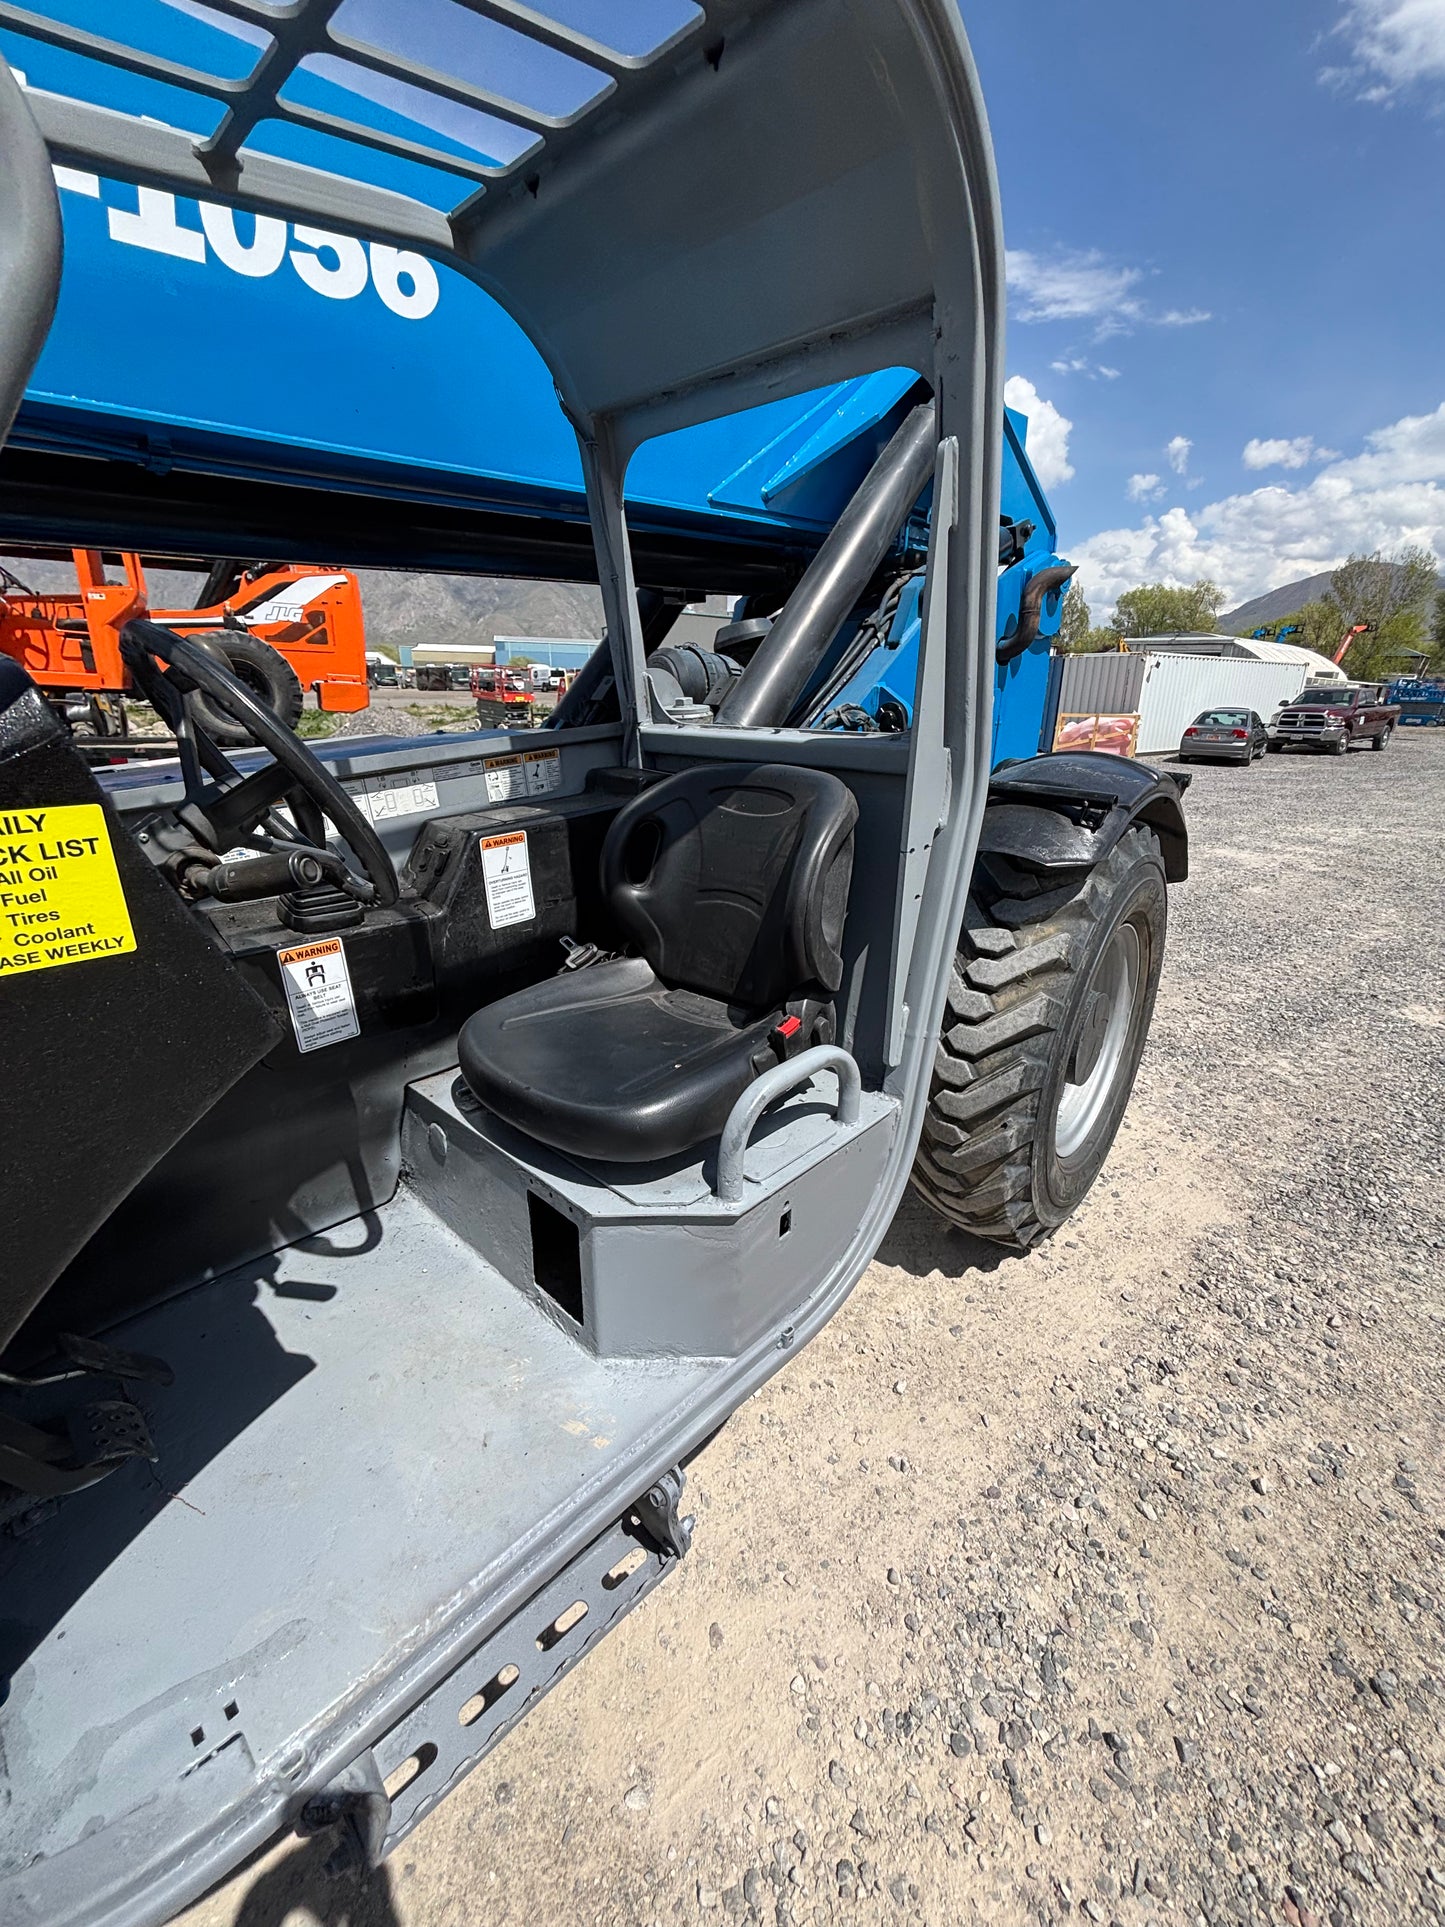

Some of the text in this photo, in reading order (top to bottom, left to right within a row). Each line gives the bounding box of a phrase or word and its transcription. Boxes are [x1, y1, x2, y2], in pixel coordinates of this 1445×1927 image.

[265, 606, 303, 623] JLG
[39, 837, 99, 861] LIST
[493, 835, 524, 846] WARNING
[0, 866, 58, 886] All Oil
[0, 888, 47, 907] Fuel
[6, 910, 60, 927] Tires
[14, 923, 95, 947] Coolant
[45, 936, 125, 960] WEEKLY
[295, 943, 338, 960] WARNING
